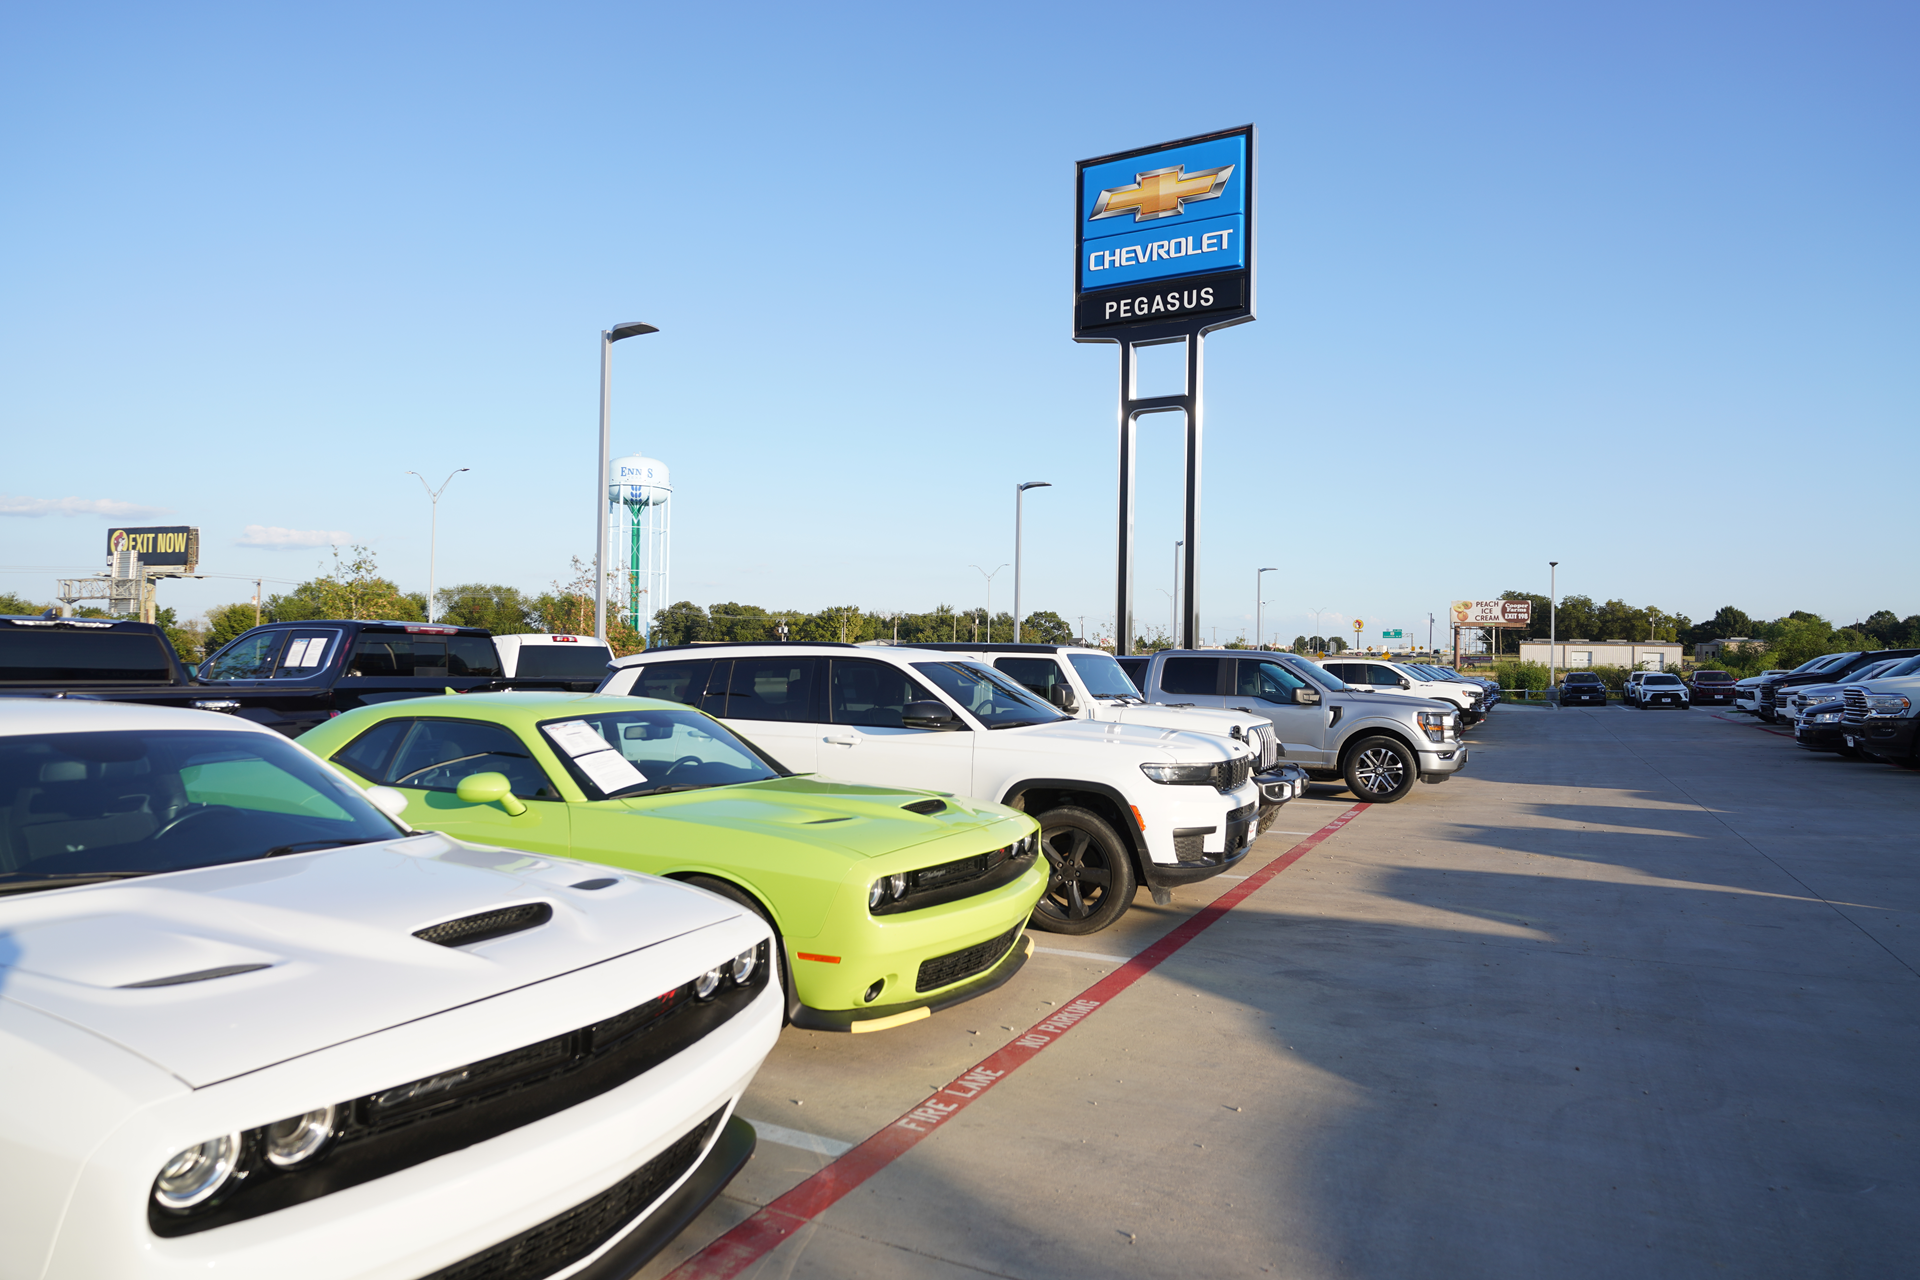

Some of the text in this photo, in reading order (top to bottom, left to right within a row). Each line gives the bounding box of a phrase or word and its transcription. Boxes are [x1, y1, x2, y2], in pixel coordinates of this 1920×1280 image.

[1089, 229, 1234, 271] CHEVROLET
[1105, 287, 1215, 320] PEGASUS
[620, 466, 653, 479] ENNS
[128, 532, 188, 553] EXIT NOW
[1015, 999, 1100, 1049] NO PARKING
[896, 1066, 1005, 1132] FIRE LANE
